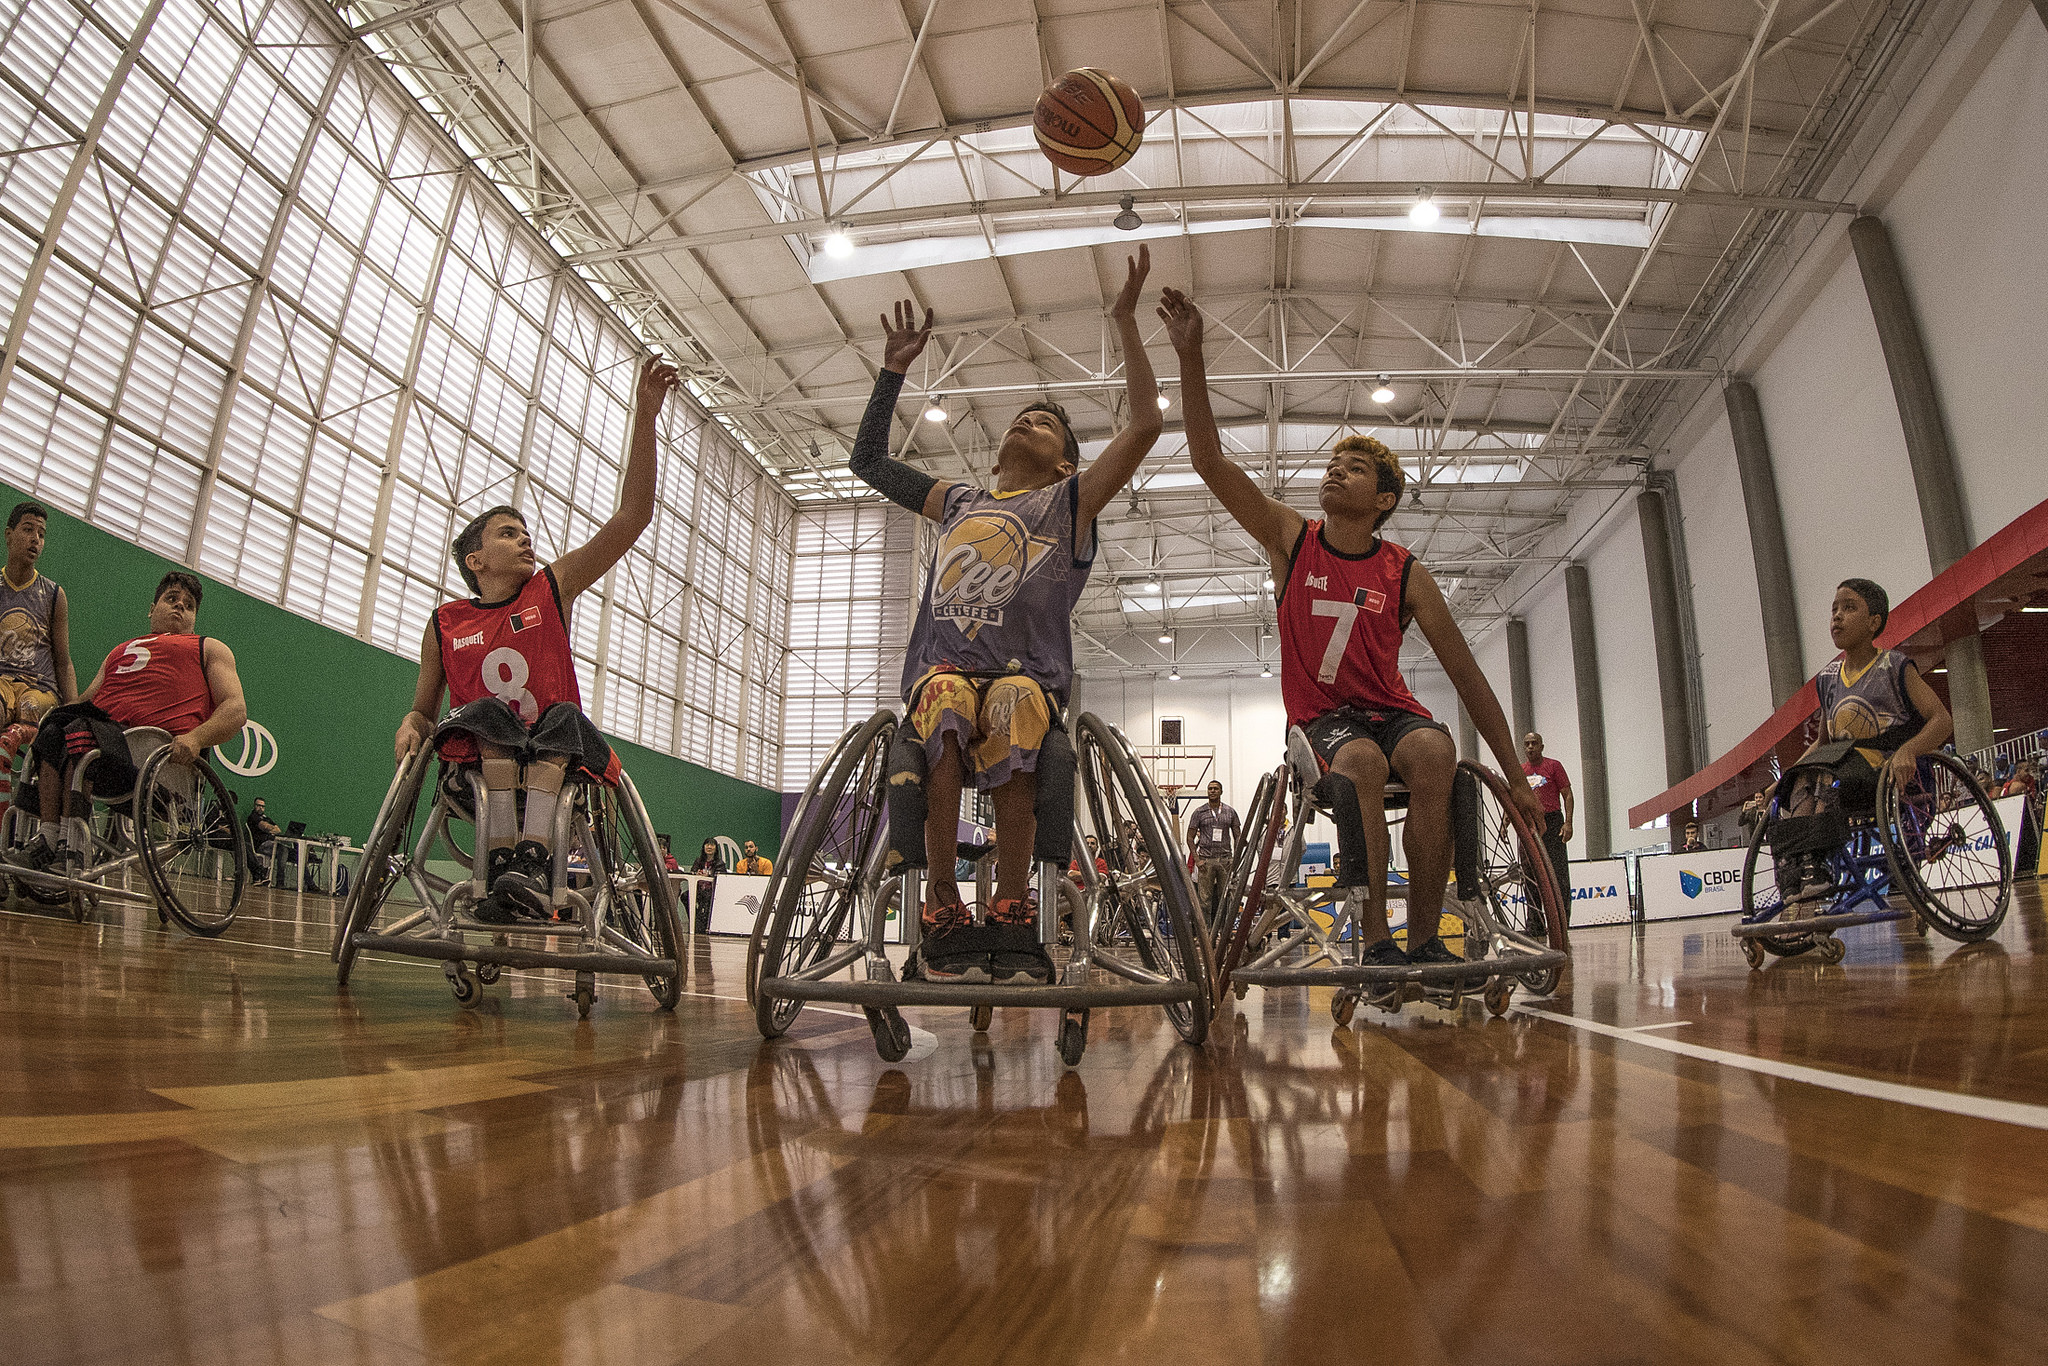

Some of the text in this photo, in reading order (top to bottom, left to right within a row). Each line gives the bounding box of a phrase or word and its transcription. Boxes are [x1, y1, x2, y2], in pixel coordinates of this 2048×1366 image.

[943, 605, 989, 619] CETEFE
[453, 630, 484, 652] BASQUETE
[1311, 599, 1359, 685] 7
[114, 636, 159, 674] 5
[481, 647, 539, 723] 8
[1975, 831, 2011, 851] CAI
[1703, 869, 1742, 886] CBDE
[1570, 885, 1618, 900] CAIXA
[1704, 885, 1725, 894] BRASIL
